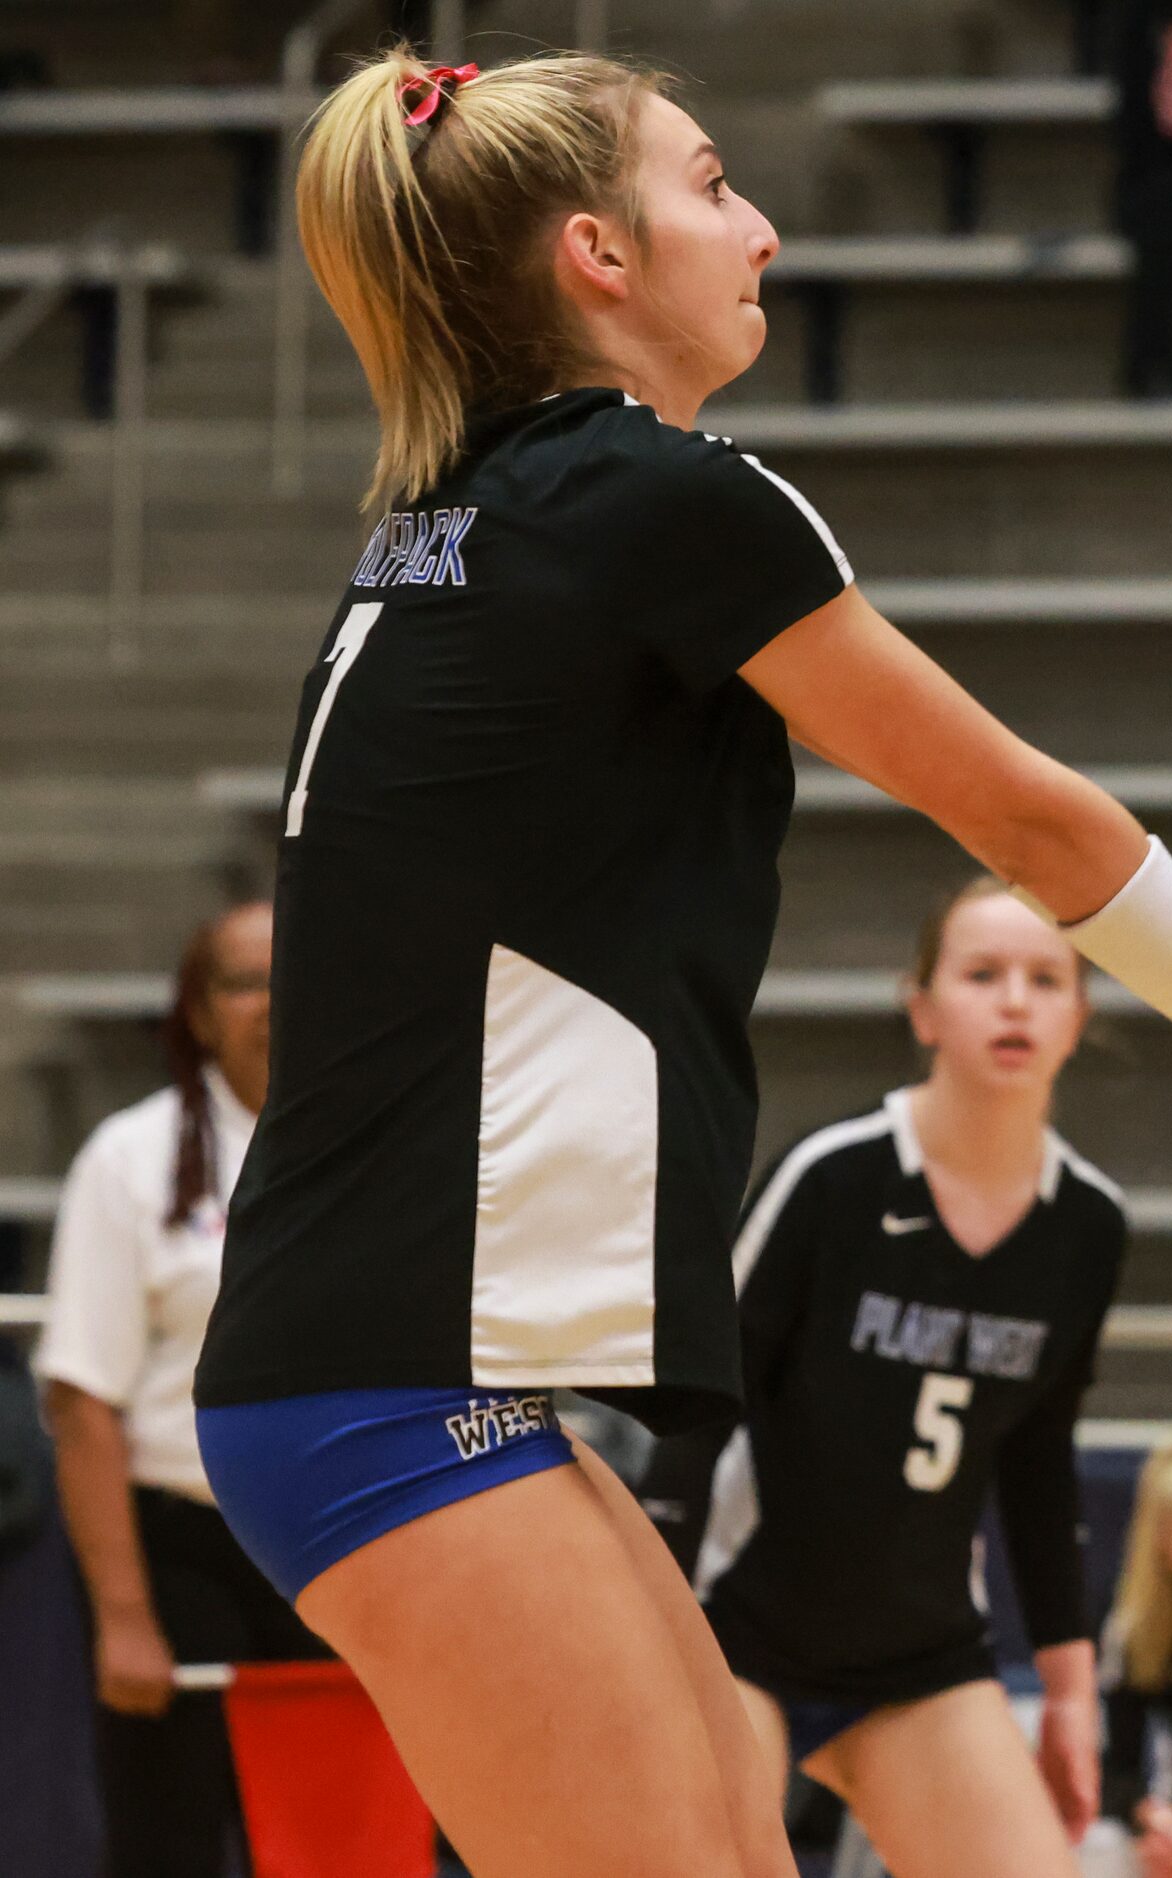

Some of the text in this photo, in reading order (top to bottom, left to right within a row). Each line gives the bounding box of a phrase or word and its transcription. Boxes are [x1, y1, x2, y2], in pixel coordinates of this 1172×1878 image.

[351, 507, 478, 587] OLFPACK
[284, 602, 384, 837] 7
[445, 1396, 551, 1460] WES
[903, 1371, 974, 1492] 5
